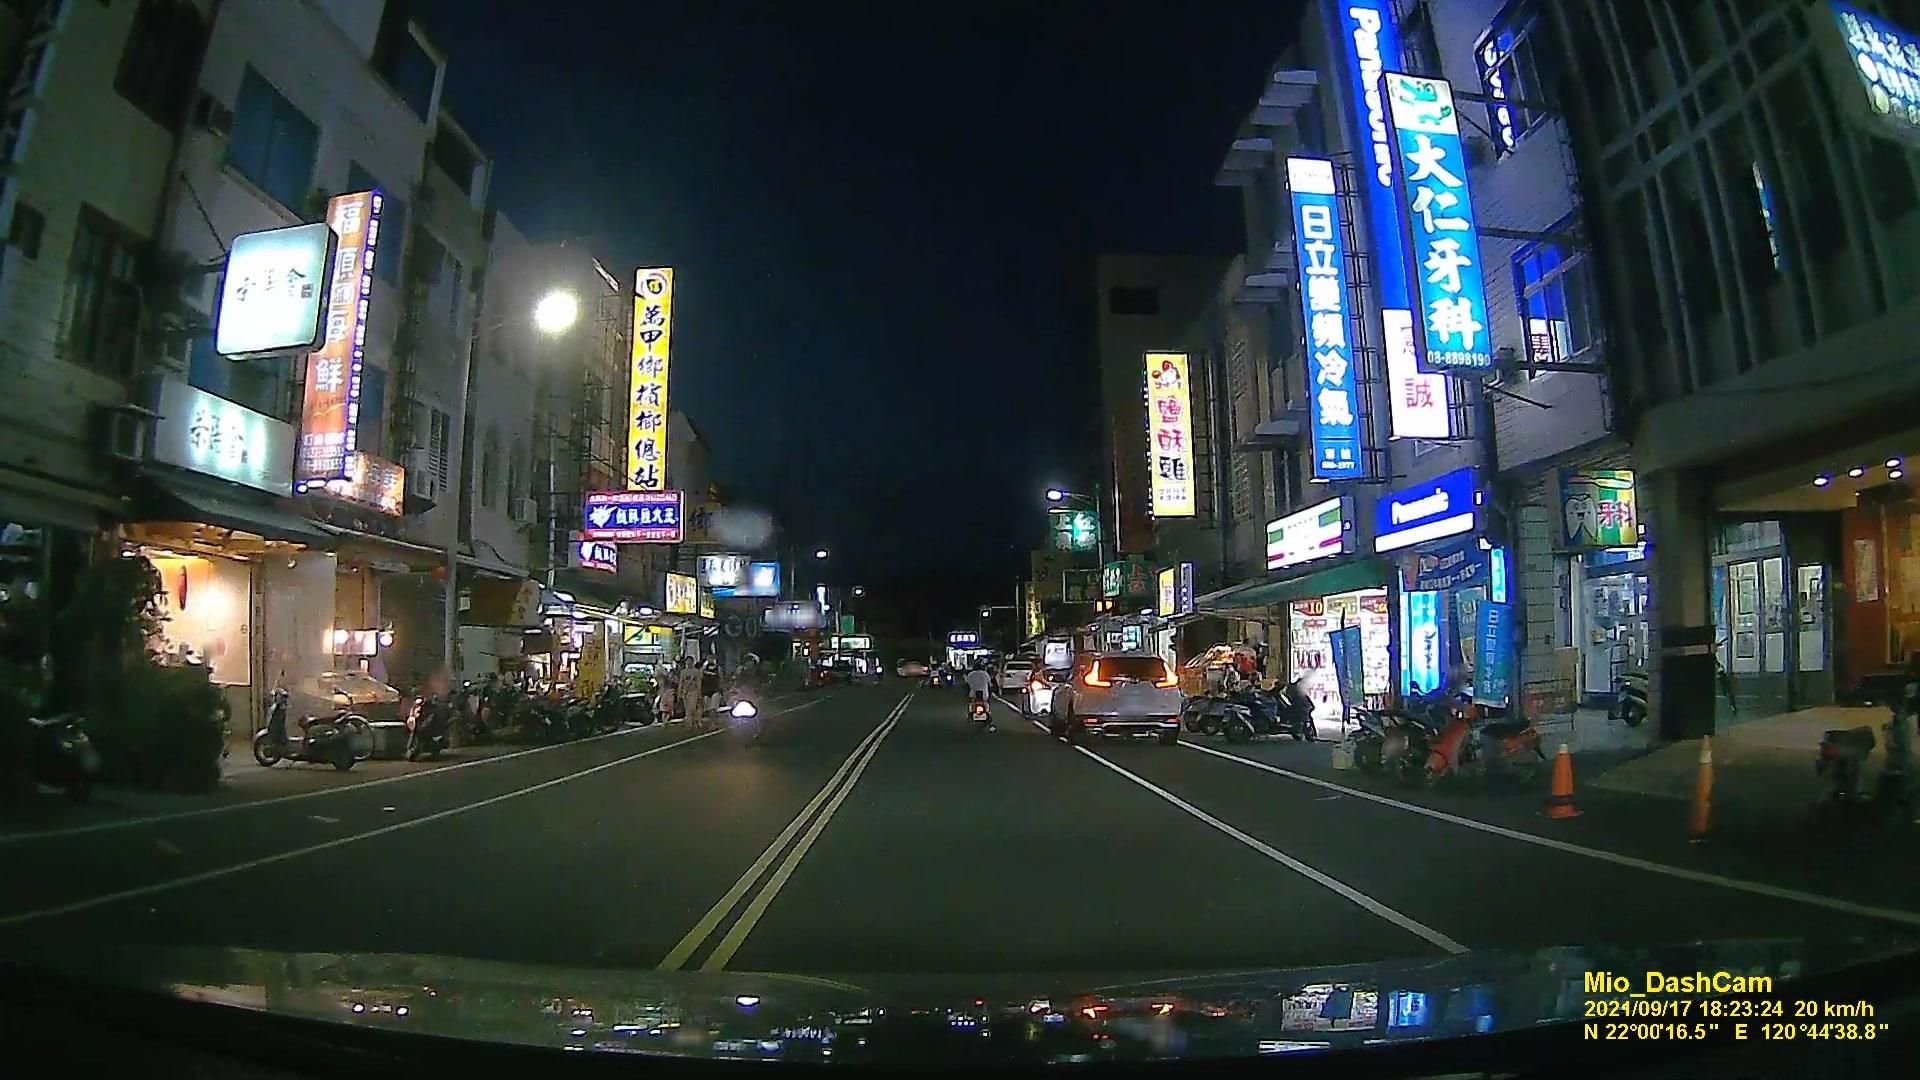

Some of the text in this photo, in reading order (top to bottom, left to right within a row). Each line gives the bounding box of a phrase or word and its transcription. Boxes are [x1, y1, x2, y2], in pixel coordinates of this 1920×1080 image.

[1406, 134, 1482, 351] 大仁牙科
[1597, 500, 1633, 528] 牙科
